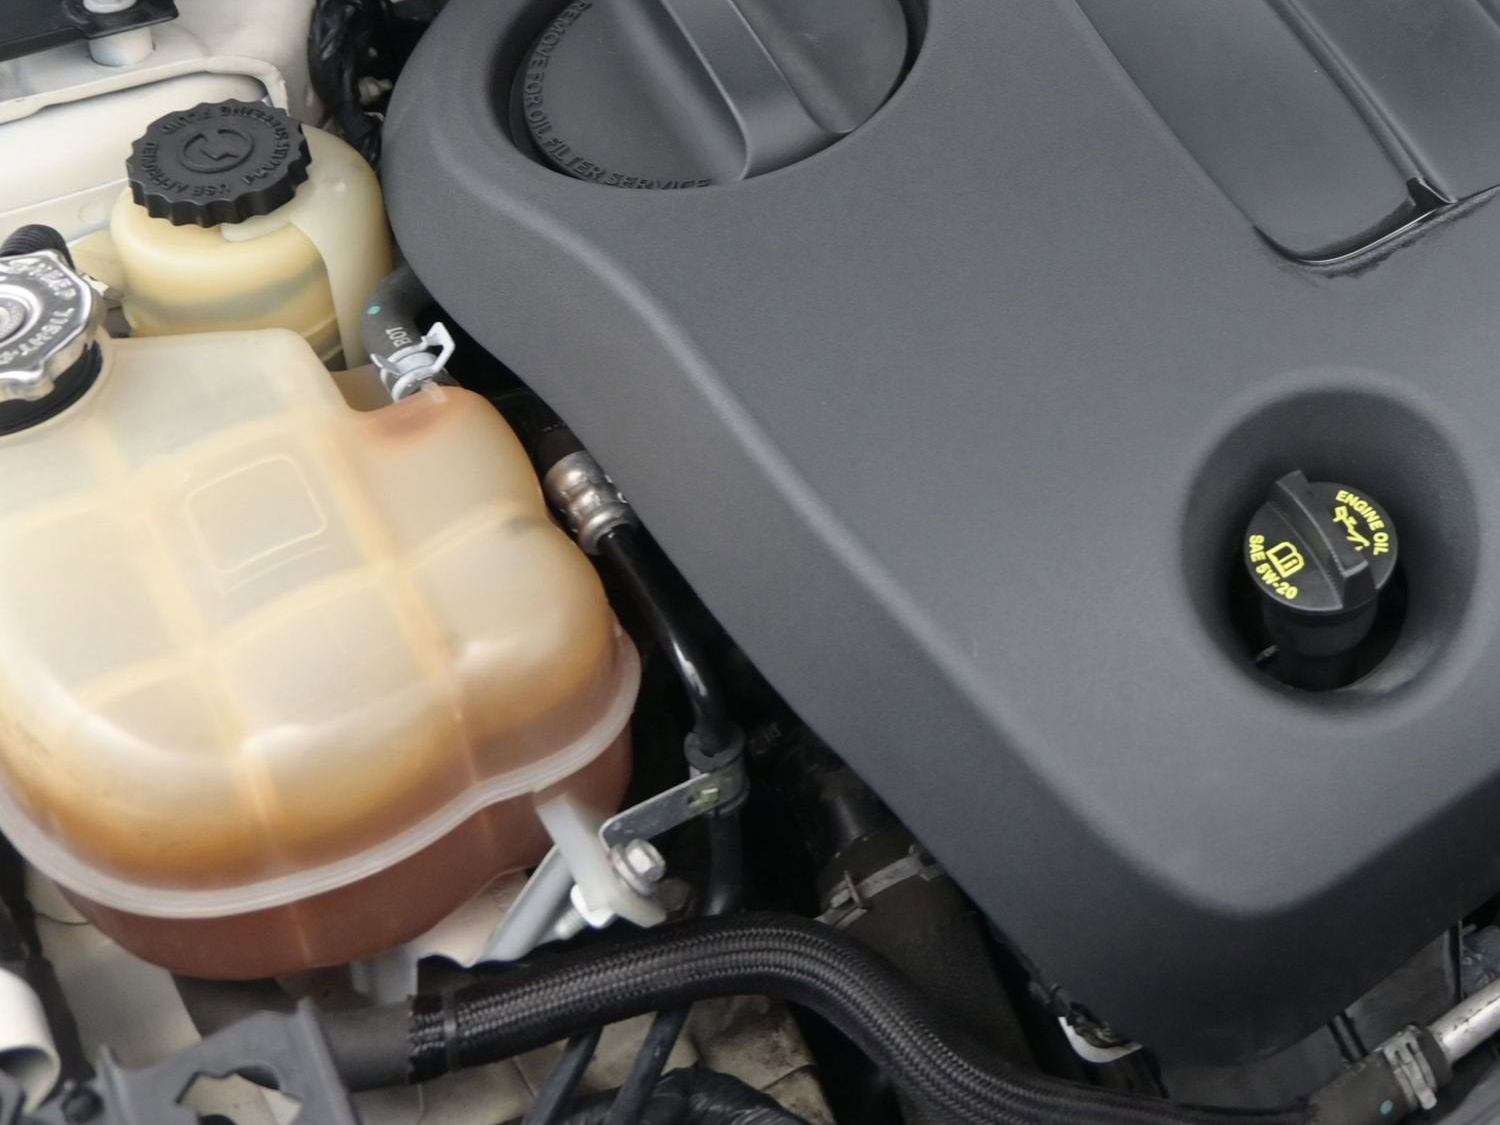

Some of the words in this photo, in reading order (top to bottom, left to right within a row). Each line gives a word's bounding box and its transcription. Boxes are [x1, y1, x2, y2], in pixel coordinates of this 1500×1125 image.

[528, 0, 592, 68] REMOVE
[524, 72, 545, 107] FOR
[528, 110, 552, 139] OIL
[544, 137, 606, 181] FILTER
[1335, 489, 1385, 531] ENGINE
[1372, 531, 1390, 556] OIL
[1248, 534, 1267, 563] SAE
[1255, 562, 1299, 600] 5W-20
